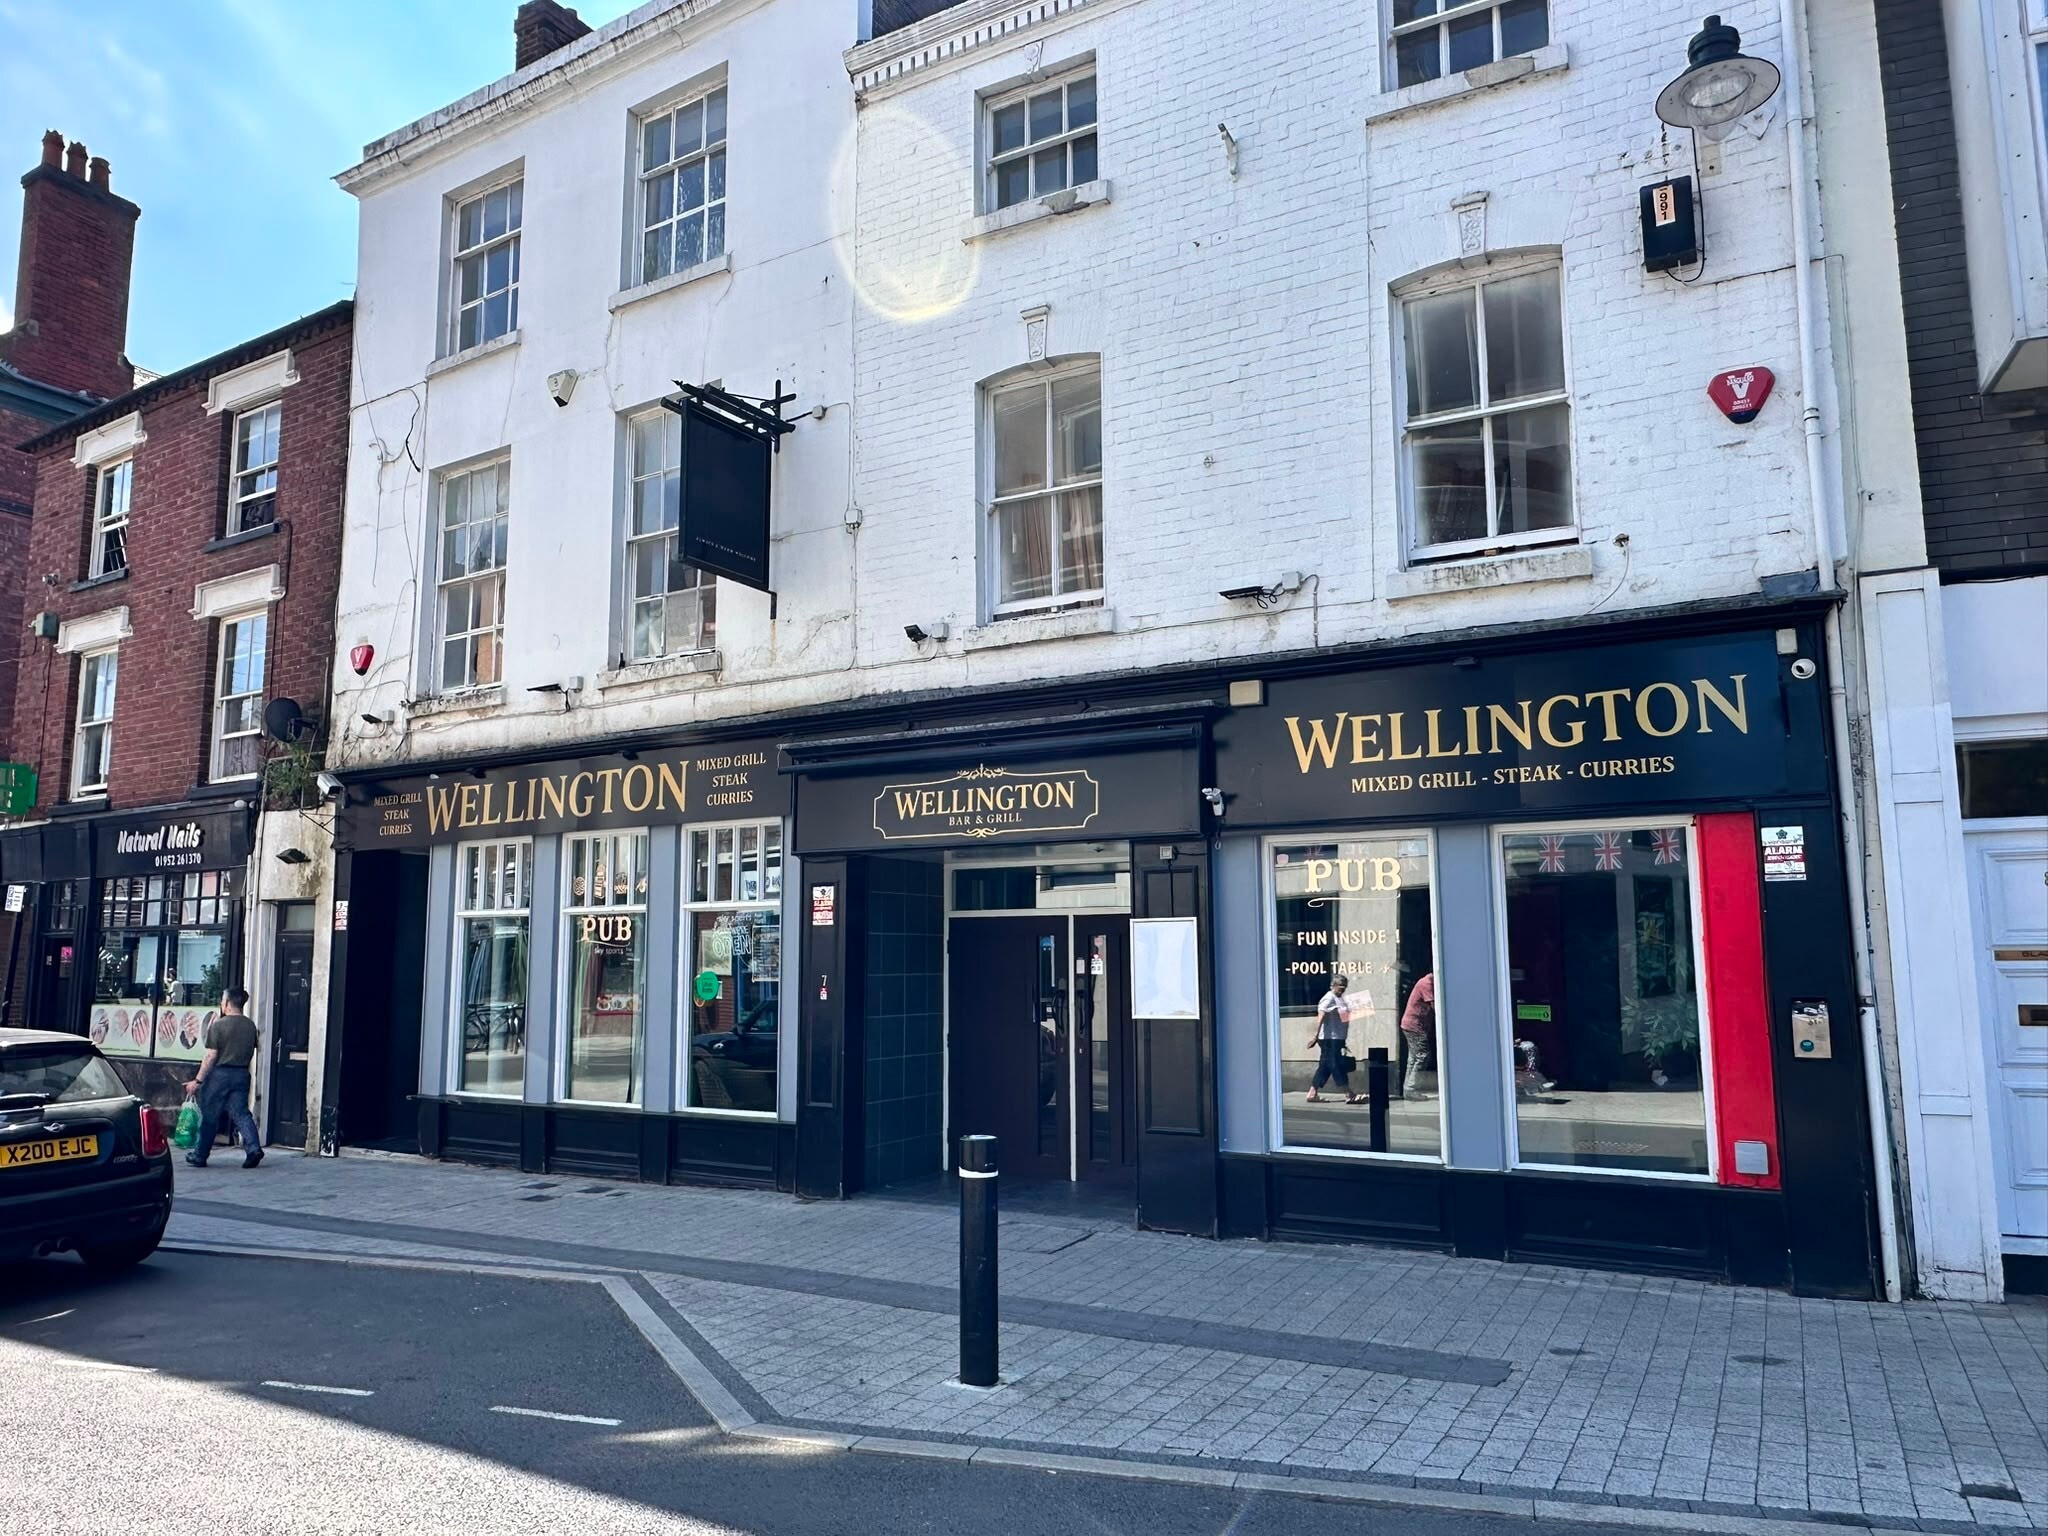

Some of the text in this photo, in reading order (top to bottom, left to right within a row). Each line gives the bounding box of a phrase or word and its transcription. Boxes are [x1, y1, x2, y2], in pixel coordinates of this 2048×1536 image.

[1284, 674, 1748, 774] WELLINGTON
[696, 752, 767, 772] MIXED GRILL
[712, 772, 748, 788] STEAK
[1351, 774, 1413, 794] MIXED
[1418, 770, 1477, 790] GRILL
[1493, 764, 1562, 785] STEAK
[1579, 755, 1675, 779] CURRIES
[374, 792, 422, 807] MIXED GRILL
[426, 760, 690, 836] WELLINGTON
[706, 790, 754, 807] CURRIES
[894, 780, 1075, 821] WELLINGTON
[384, 808, 410, 821] STEAK
[949, 812, 1022, 826] BAR & GRILL
[117, 822, 201, 854] Natural Nails
[379, 823, 412, 836] CURRIES
[1764, 845, 1803, 856] ALARM
[155, 852, 201, 867] 01952 261370
[1304, 857, 1402, 892] PUB
[580, 915, 632, 942] PUB
[1297, 930, 1327, 946] FUN
[1333, 929, 1387, 945] INSIDE
[1330, 961, 1373, 975] TABLE
[821, 974, 828, 987] 7
[7, 1139, 92, 1163] X200 EJC
